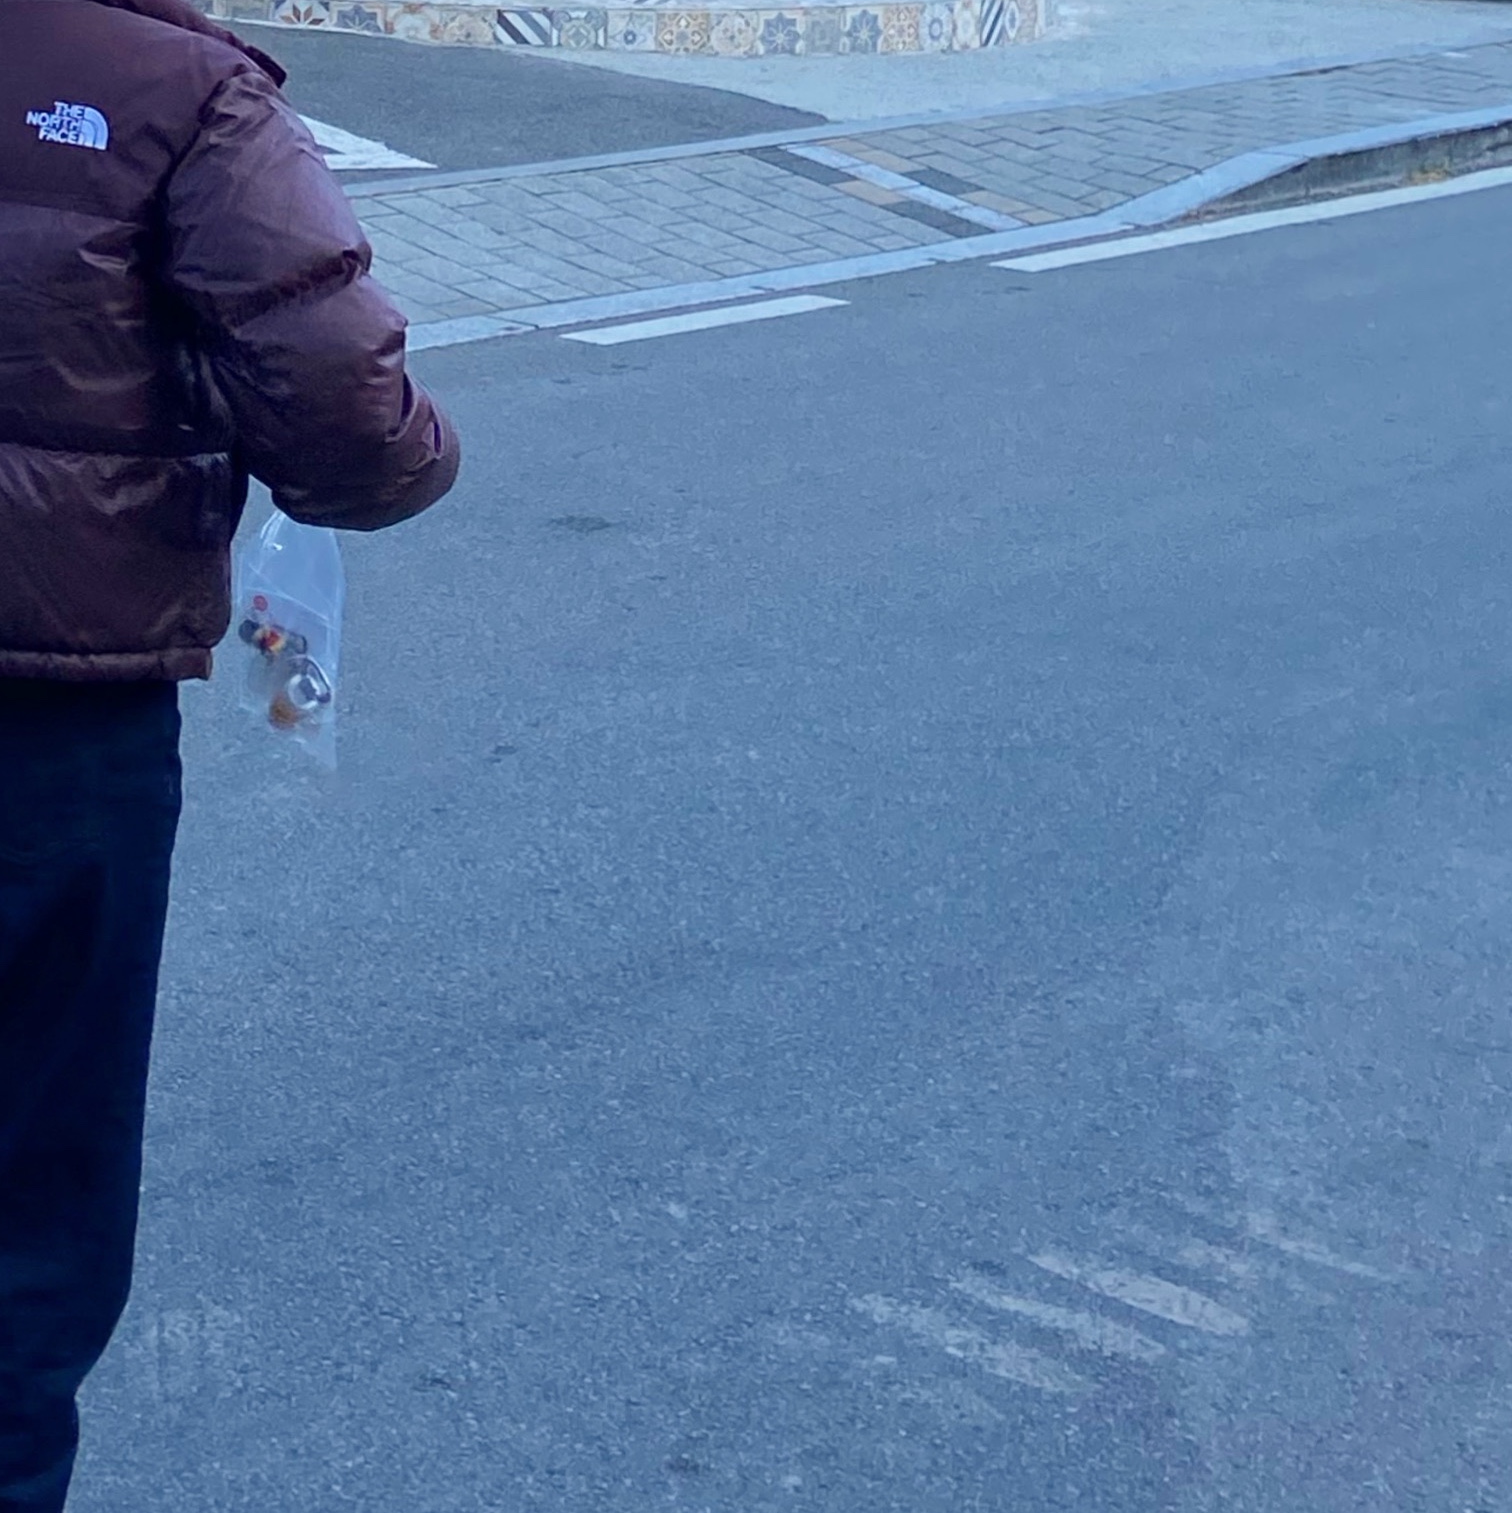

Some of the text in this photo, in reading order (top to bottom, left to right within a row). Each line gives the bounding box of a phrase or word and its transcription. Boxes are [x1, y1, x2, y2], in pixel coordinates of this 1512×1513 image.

[54, 101, 85, 119] THE
[26, 111, 83, 132] NORTH
[38, 126, 80, 145] FACE
